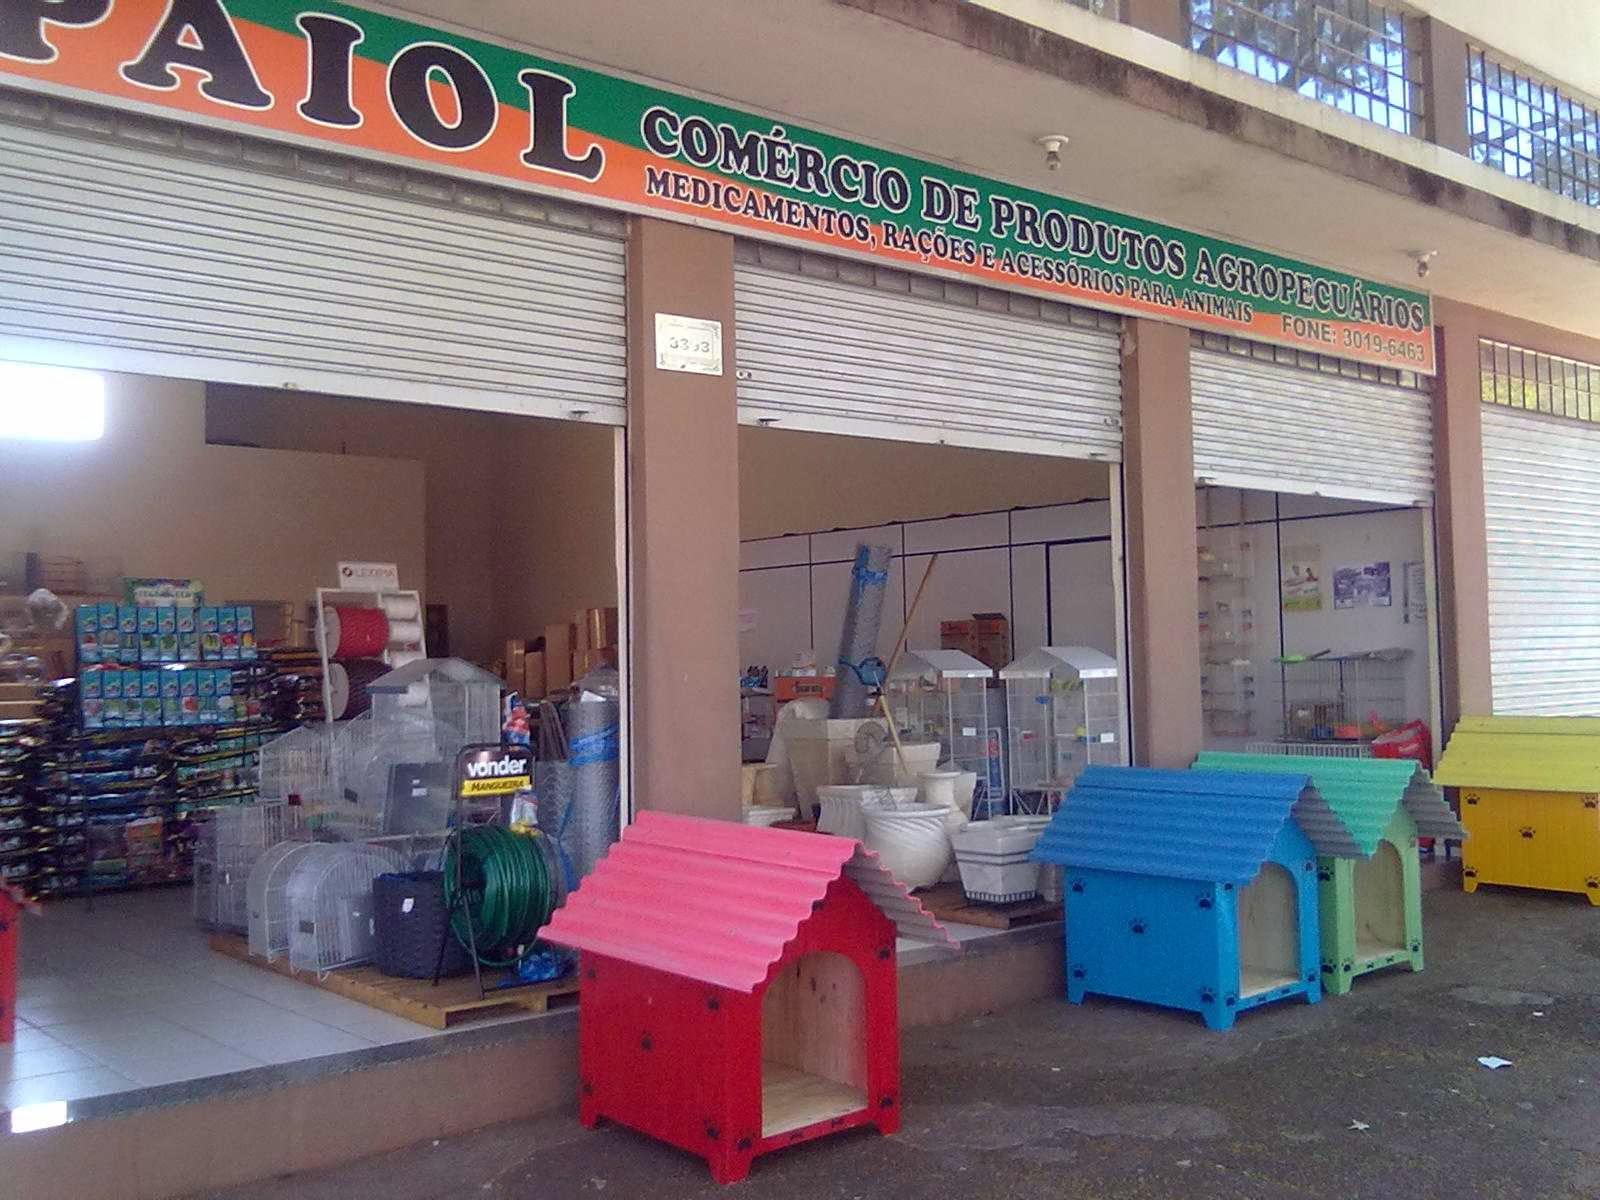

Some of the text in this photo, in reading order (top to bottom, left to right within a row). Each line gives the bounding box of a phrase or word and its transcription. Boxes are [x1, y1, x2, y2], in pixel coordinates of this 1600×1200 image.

[641, 106, 1425, 333] COMÉRCIO DE PRODUTOS AGROPECUÁRIOS
[645, 166, 1253, 323] MEDICAMENTOS, RAÇÕES E ACESSÓRIOS PARA ANIMAIS
[1282, 313, 1425, 362] FONE: 3019-6463
[467, 755, 527, 777] vonder
